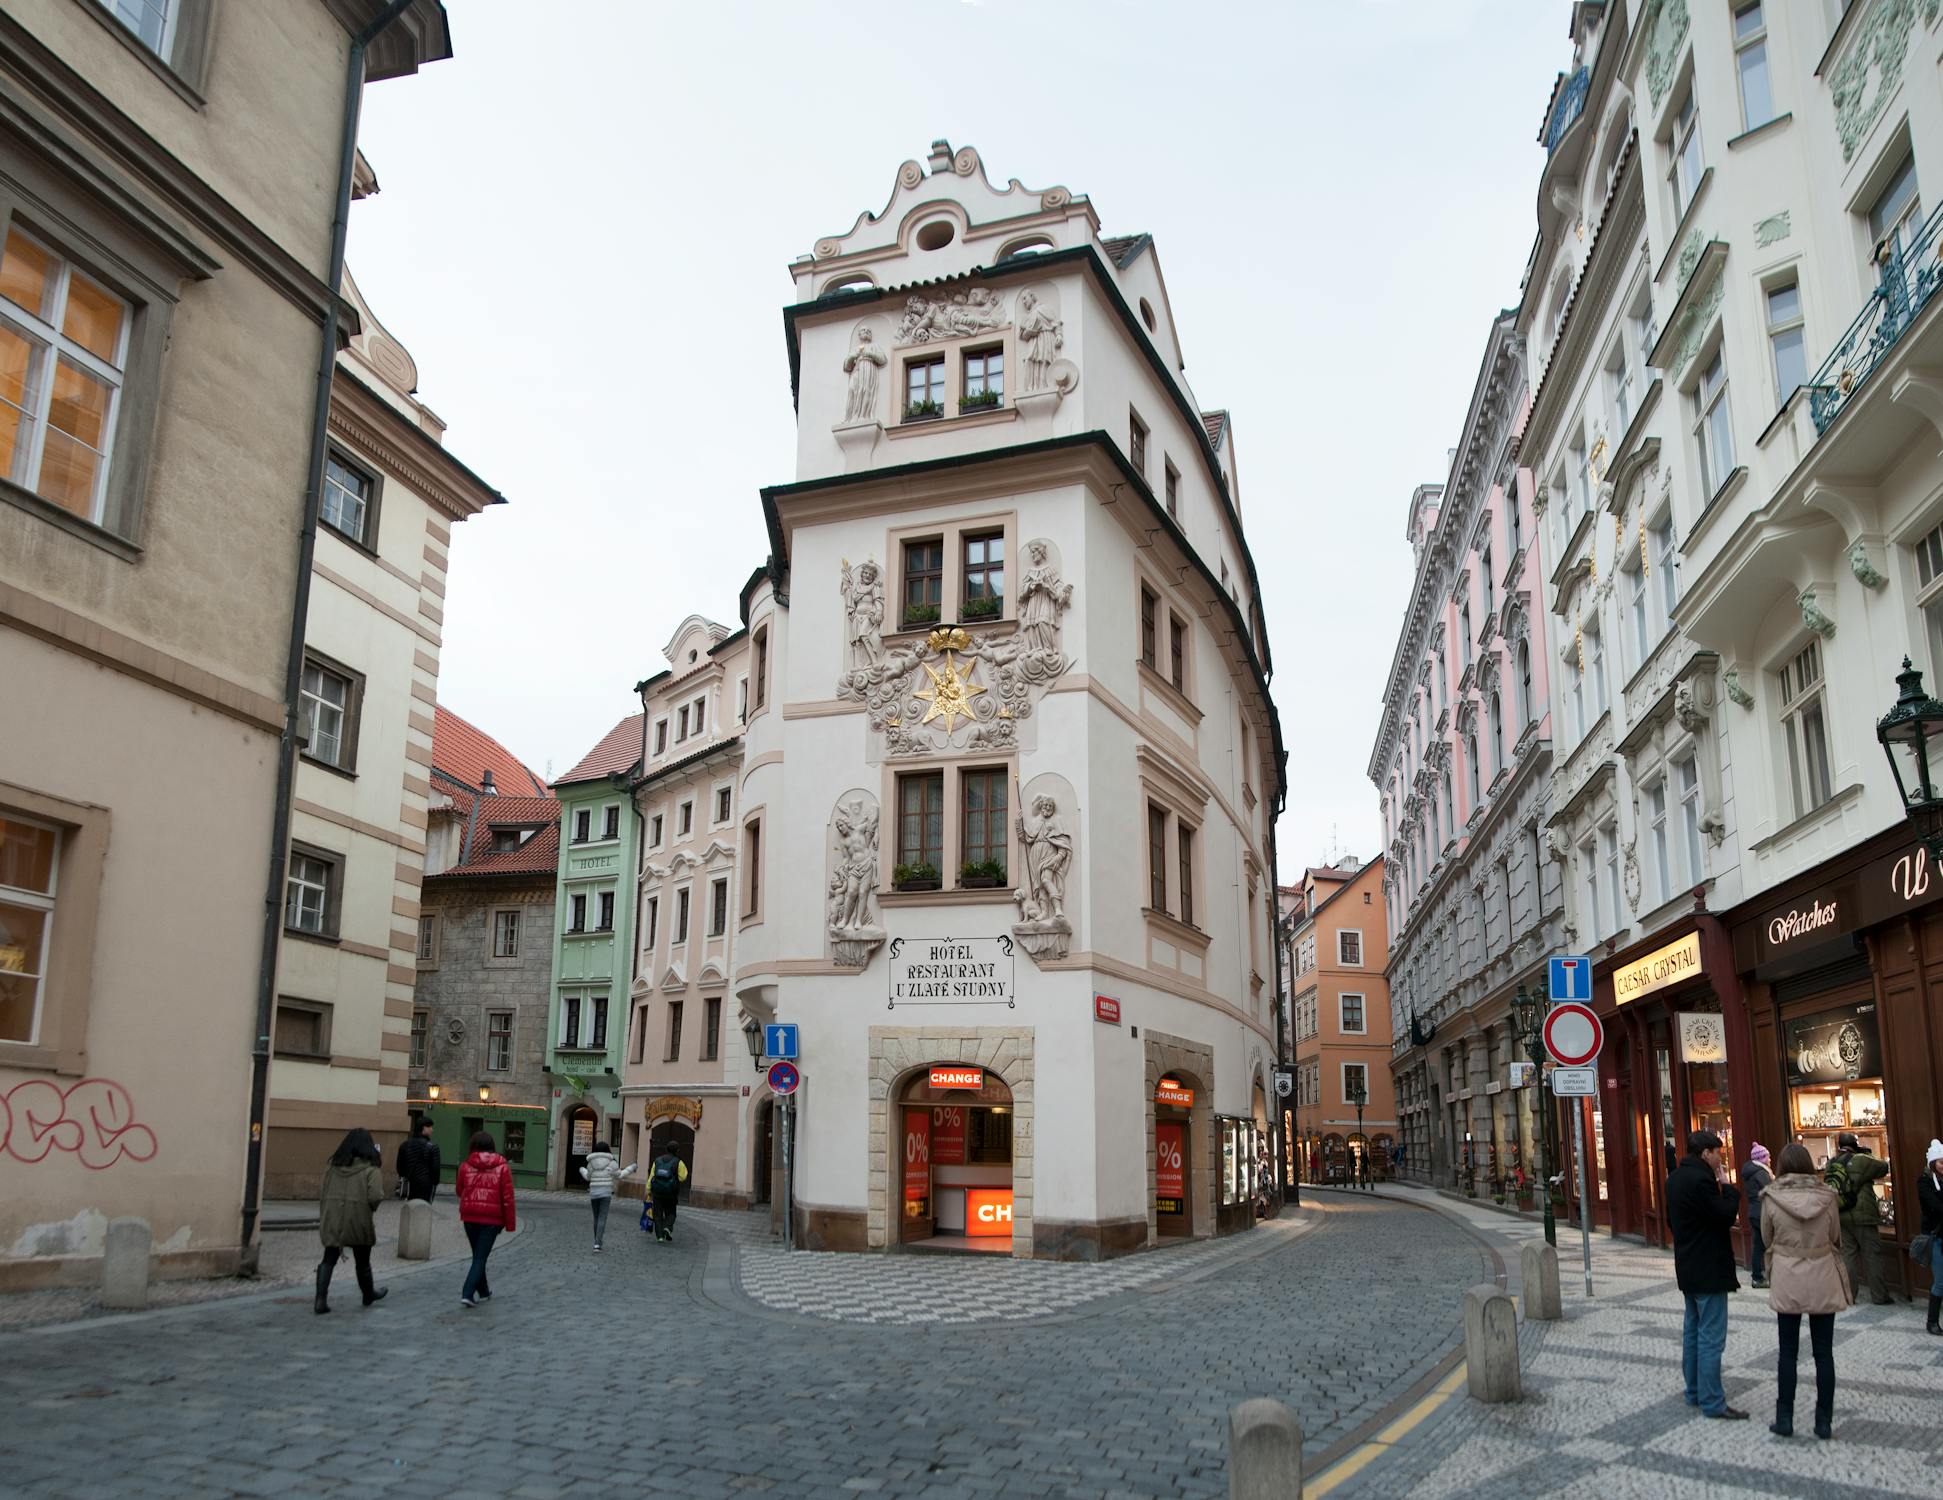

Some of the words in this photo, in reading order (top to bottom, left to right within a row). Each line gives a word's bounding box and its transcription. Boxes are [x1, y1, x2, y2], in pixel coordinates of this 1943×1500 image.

[580, 857, 611, 869] HOTEL
[1769, 900, 1836, 944] Watches
[930, 945, 973, 960] HOTEL
[908, 963, 995, 979] RESTAURANT
[1617, 966, 1651, 995] CAESAR
[1653, 947, 1696, 981] CRYSTAL
[896, 983, 905, 997] U
[908, 980, 949, 997] ZLATÉ
[953, 982, 1006, 997] STUDNY
[930, 1073, 981, 1084] CHANGE
[934, 1106, 961, 1128] 0%
[906, 1132, 929, 1163] 0%
[977, 1204, 1012, 1222] CH
